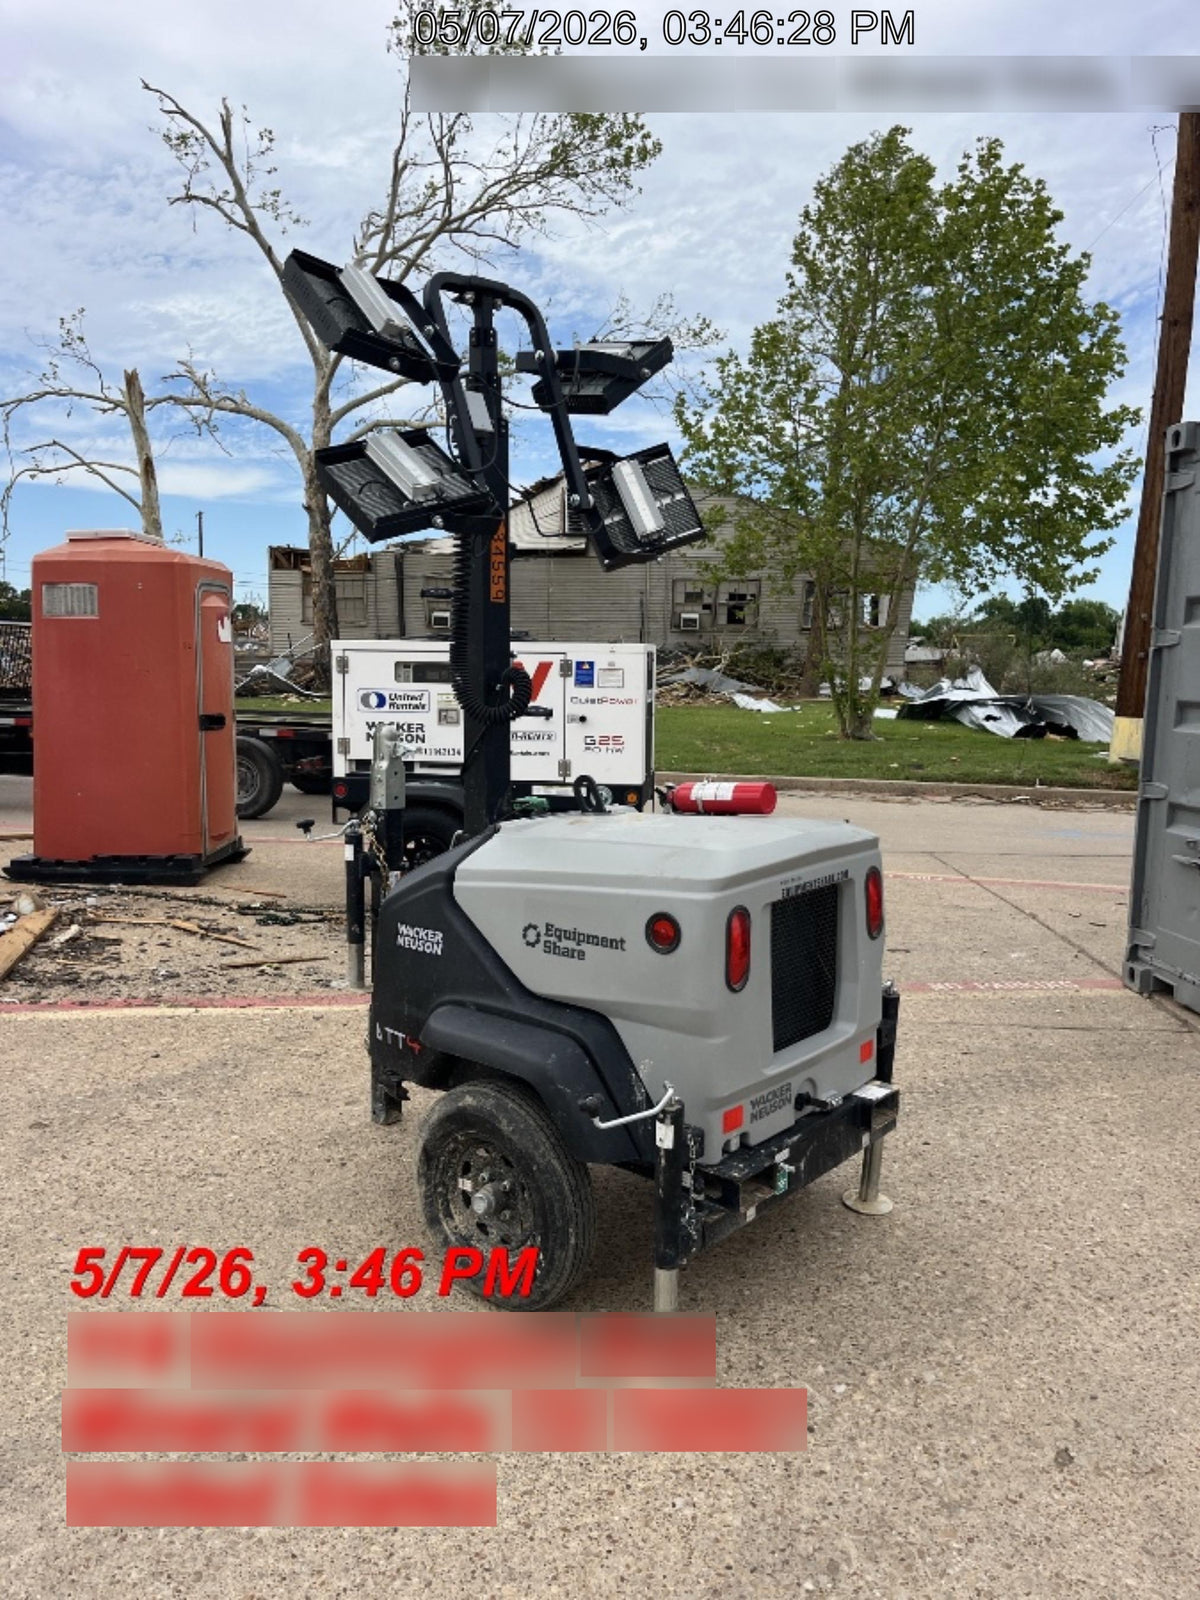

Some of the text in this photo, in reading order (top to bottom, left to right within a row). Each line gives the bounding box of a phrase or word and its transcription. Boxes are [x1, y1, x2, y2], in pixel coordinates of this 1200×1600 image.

[397, 921, 444, 942] WACKER
[543, 922, 626, 952] Equipment
[396, 934, 443, 956] NEUSON
[543, 939, 586, 961] Share
[749, 1081, 793, 1110] WACKER
[749, 1092, 793, 1124] NEUSON
